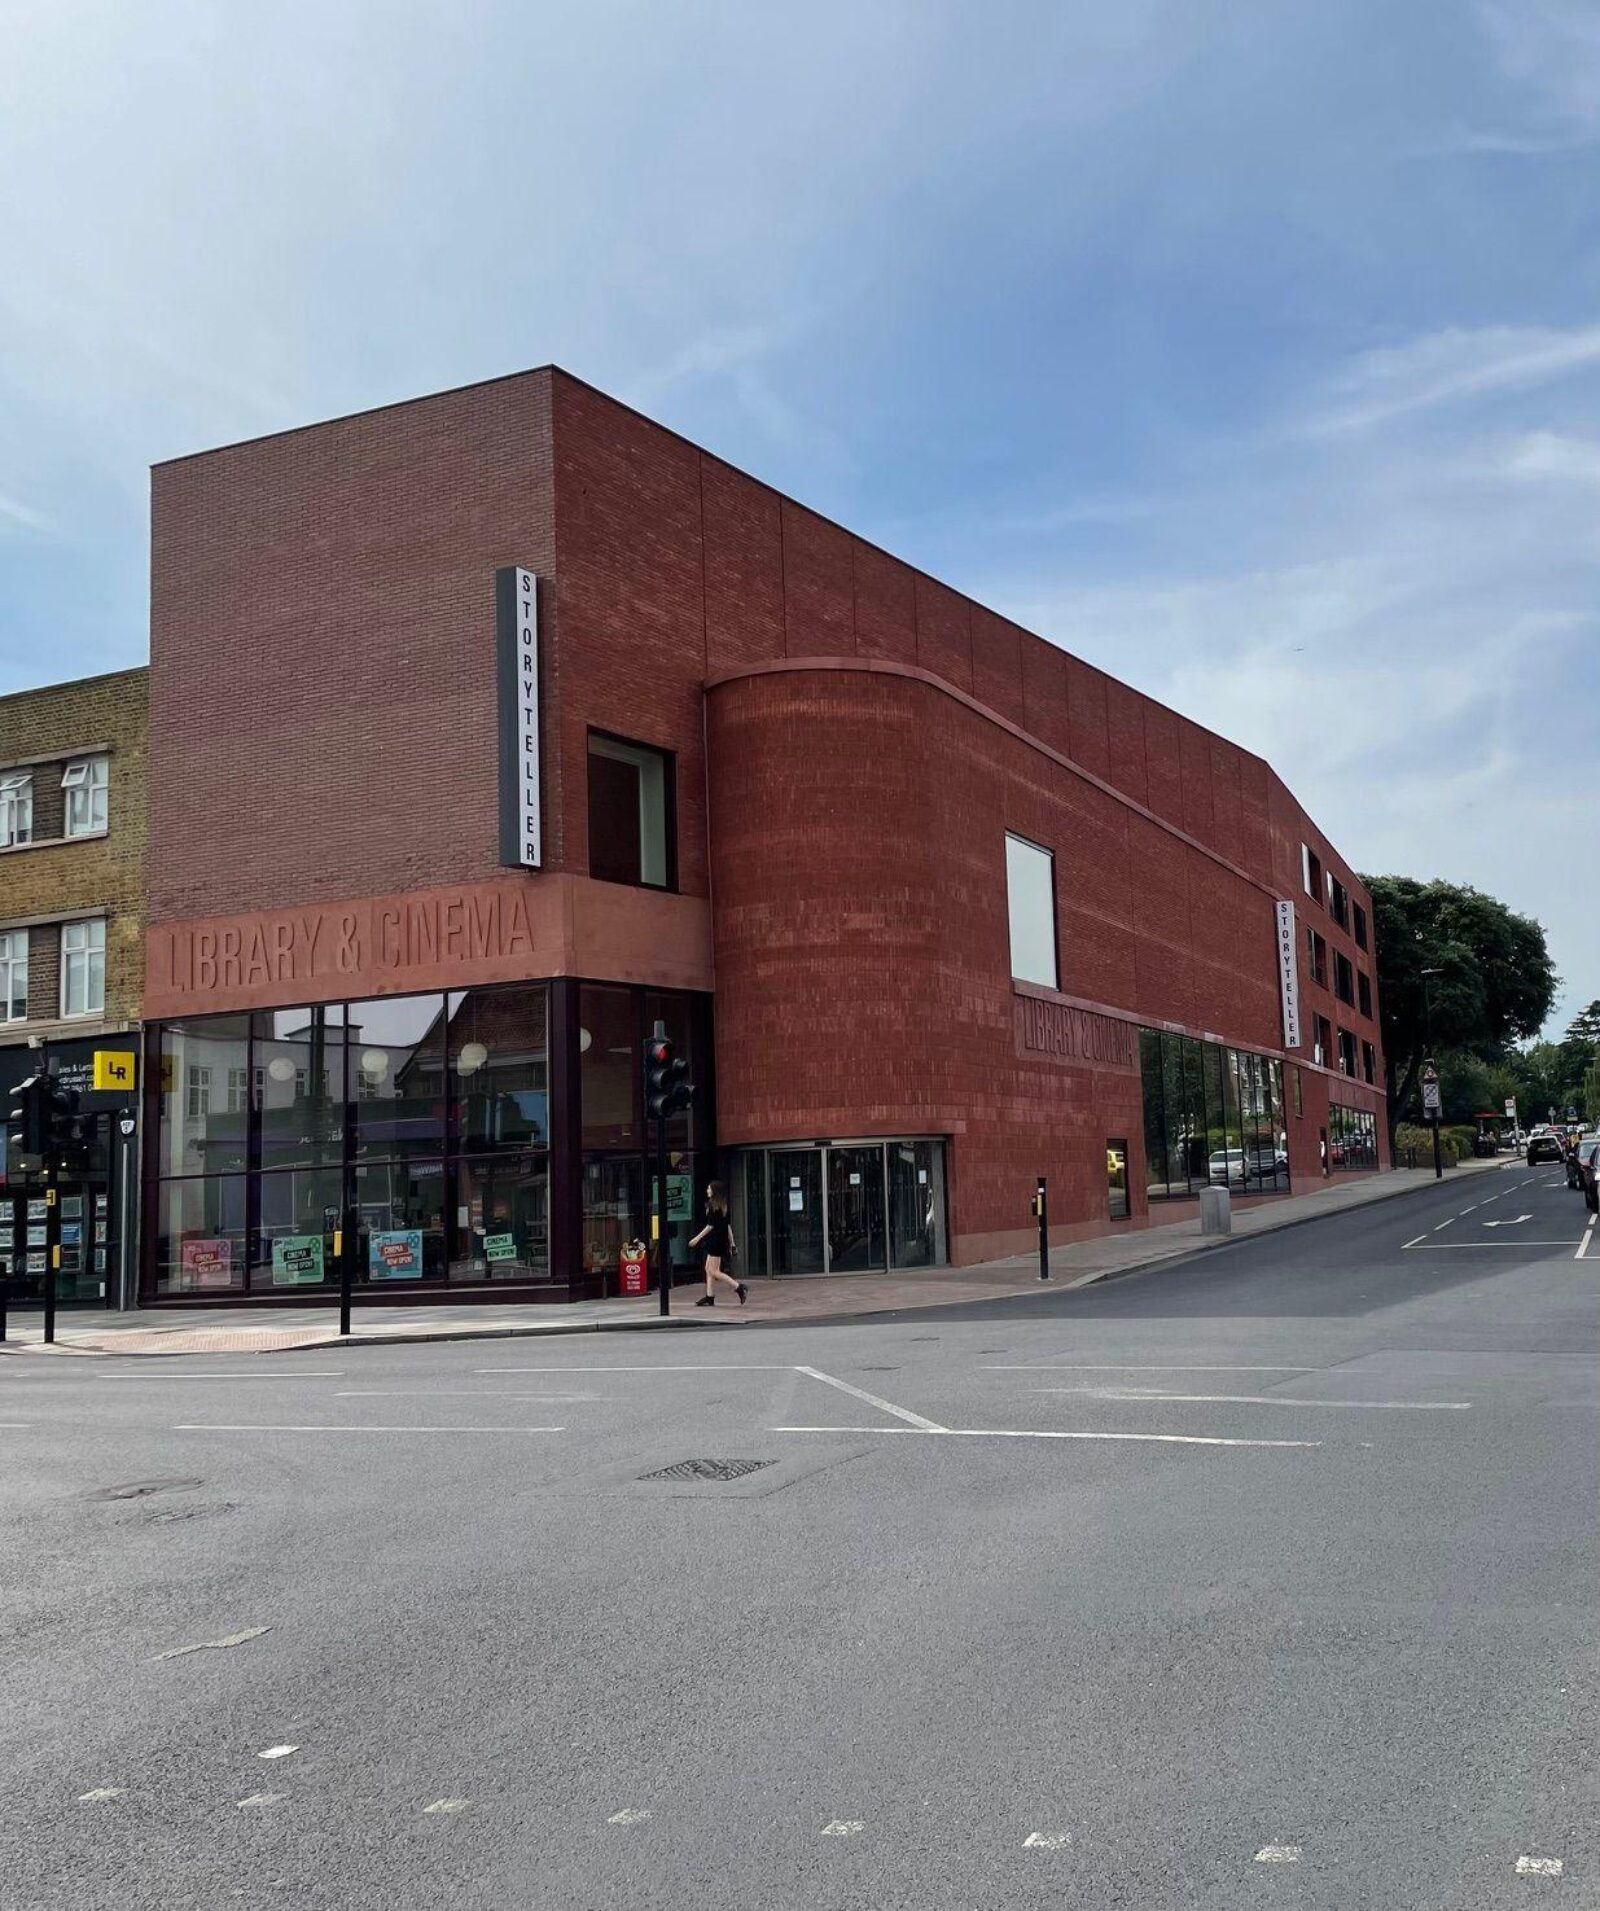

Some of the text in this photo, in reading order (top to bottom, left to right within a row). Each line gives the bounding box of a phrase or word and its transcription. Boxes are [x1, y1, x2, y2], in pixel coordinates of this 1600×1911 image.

[522, 574, 535, 861] STORYTELLER
[170, 888, 536, 993] LIBRARY & CINEMA
[1280, 903, 1296, 1046] STORYTELLER
